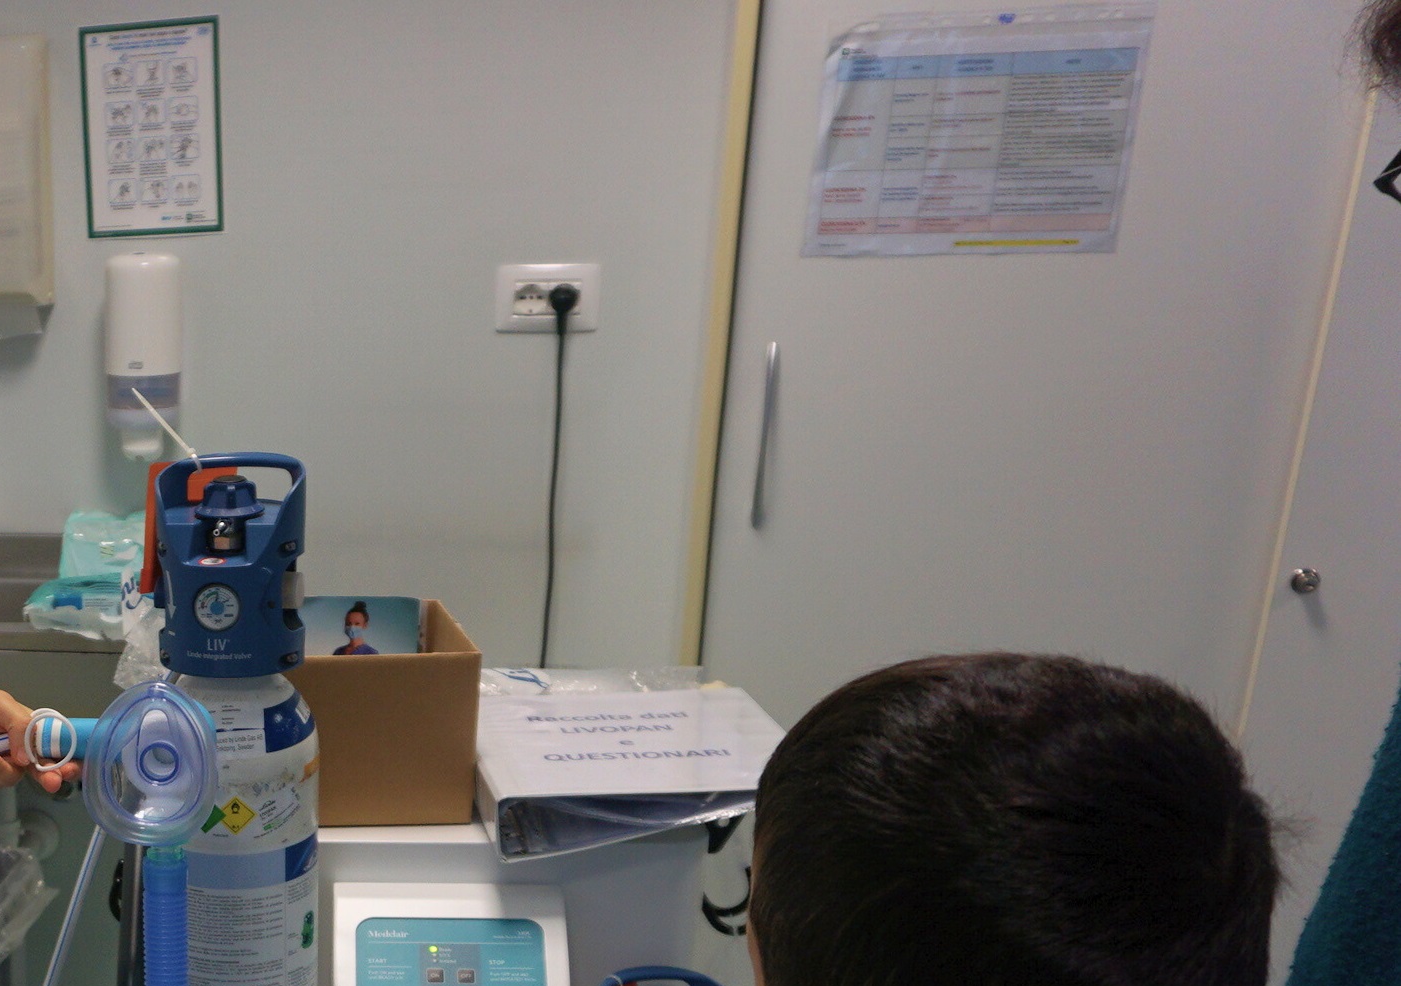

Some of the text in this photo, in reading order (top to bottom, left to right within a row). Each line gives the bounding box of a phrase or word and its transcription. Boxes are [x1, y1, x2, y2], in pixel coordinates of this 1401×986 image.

[526, 712, 632, 723] Raccolta
[560, 723, 673, 734] LIVOPAN
[543, 748, 732, 762] QUESTIONARI
